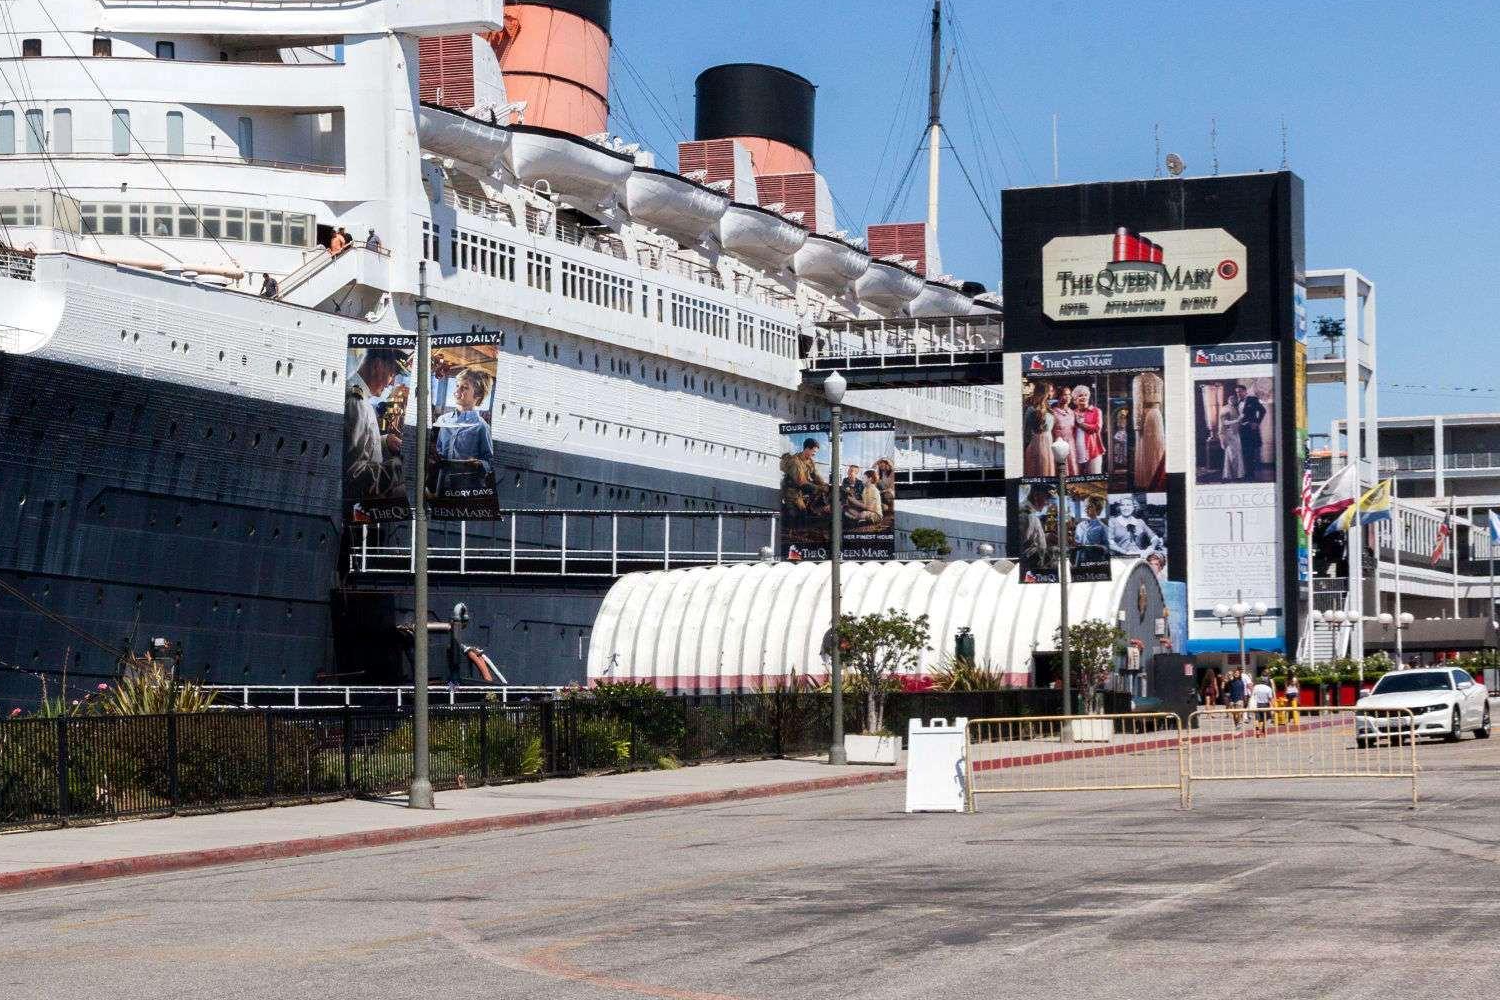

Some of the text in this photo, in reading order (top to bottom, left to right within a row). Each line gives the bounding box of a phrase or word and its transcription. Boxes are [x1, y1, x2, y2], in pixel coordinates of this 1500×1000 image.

[1098, 268, 1159, 295] QUEEN
[1160, 266, 1215, 289] MARY
[1060, 297, 1218, 313] HOTEL ATTRACTIONS EVENTS
[351, 336, 385, 345] TOURS
[466, 334, 496, 343] DAILY
[1061, 358, 1088, 370] QUEEN
[1089, 357, 1113, 367] MARY
[1224, 352, 1250, 363] QUEEN
[1251, 351, 1273, 360] MARY
[782, 424, 808, 432] TOURS
[445, 488, 494, 498] GLORY DAYS
[1195, 493, 1274, 507] ART DECO
[1200, 544, 1271, 558] FESTIVAL
